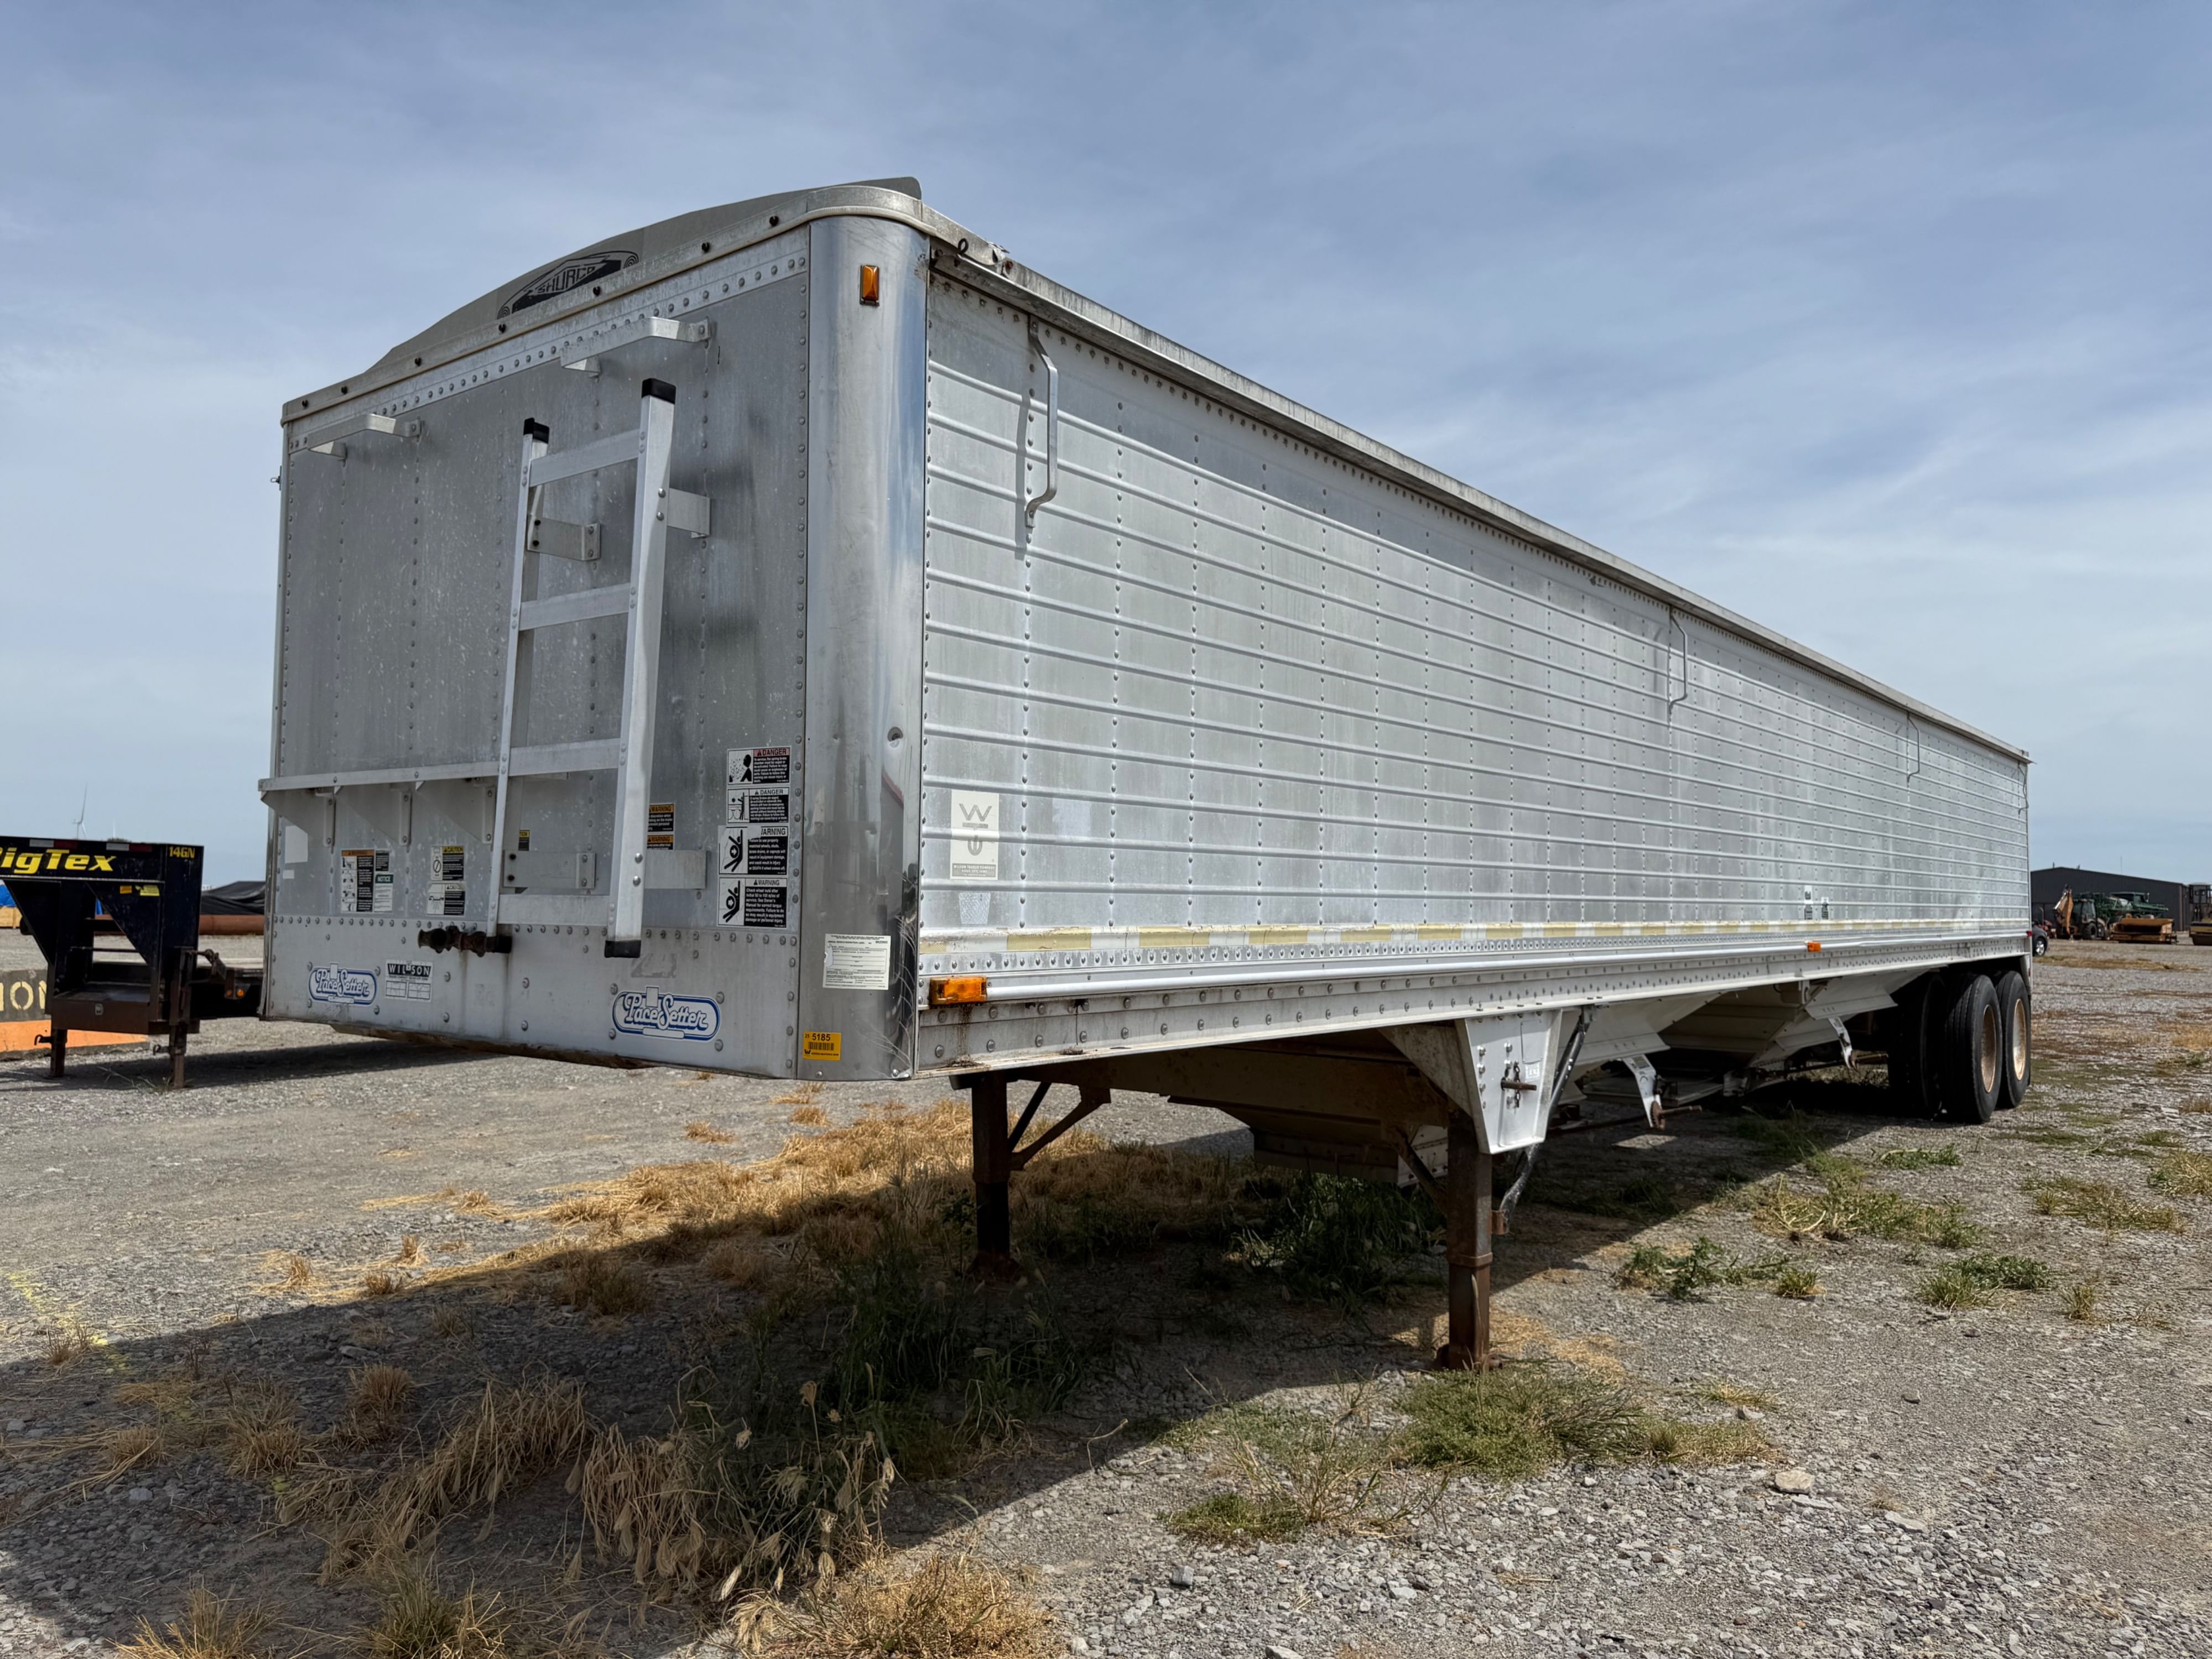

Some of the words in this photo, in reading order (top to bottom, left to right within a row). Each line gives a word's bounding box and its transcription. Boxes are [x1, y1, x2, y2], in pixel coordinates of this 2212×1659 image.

[169, 846, 195, 858] 14GN
[0, 847, 116, 874] igTex
[389, 964, 430, 975] WILSON
[812, 1033, 831, 1041] 5185
